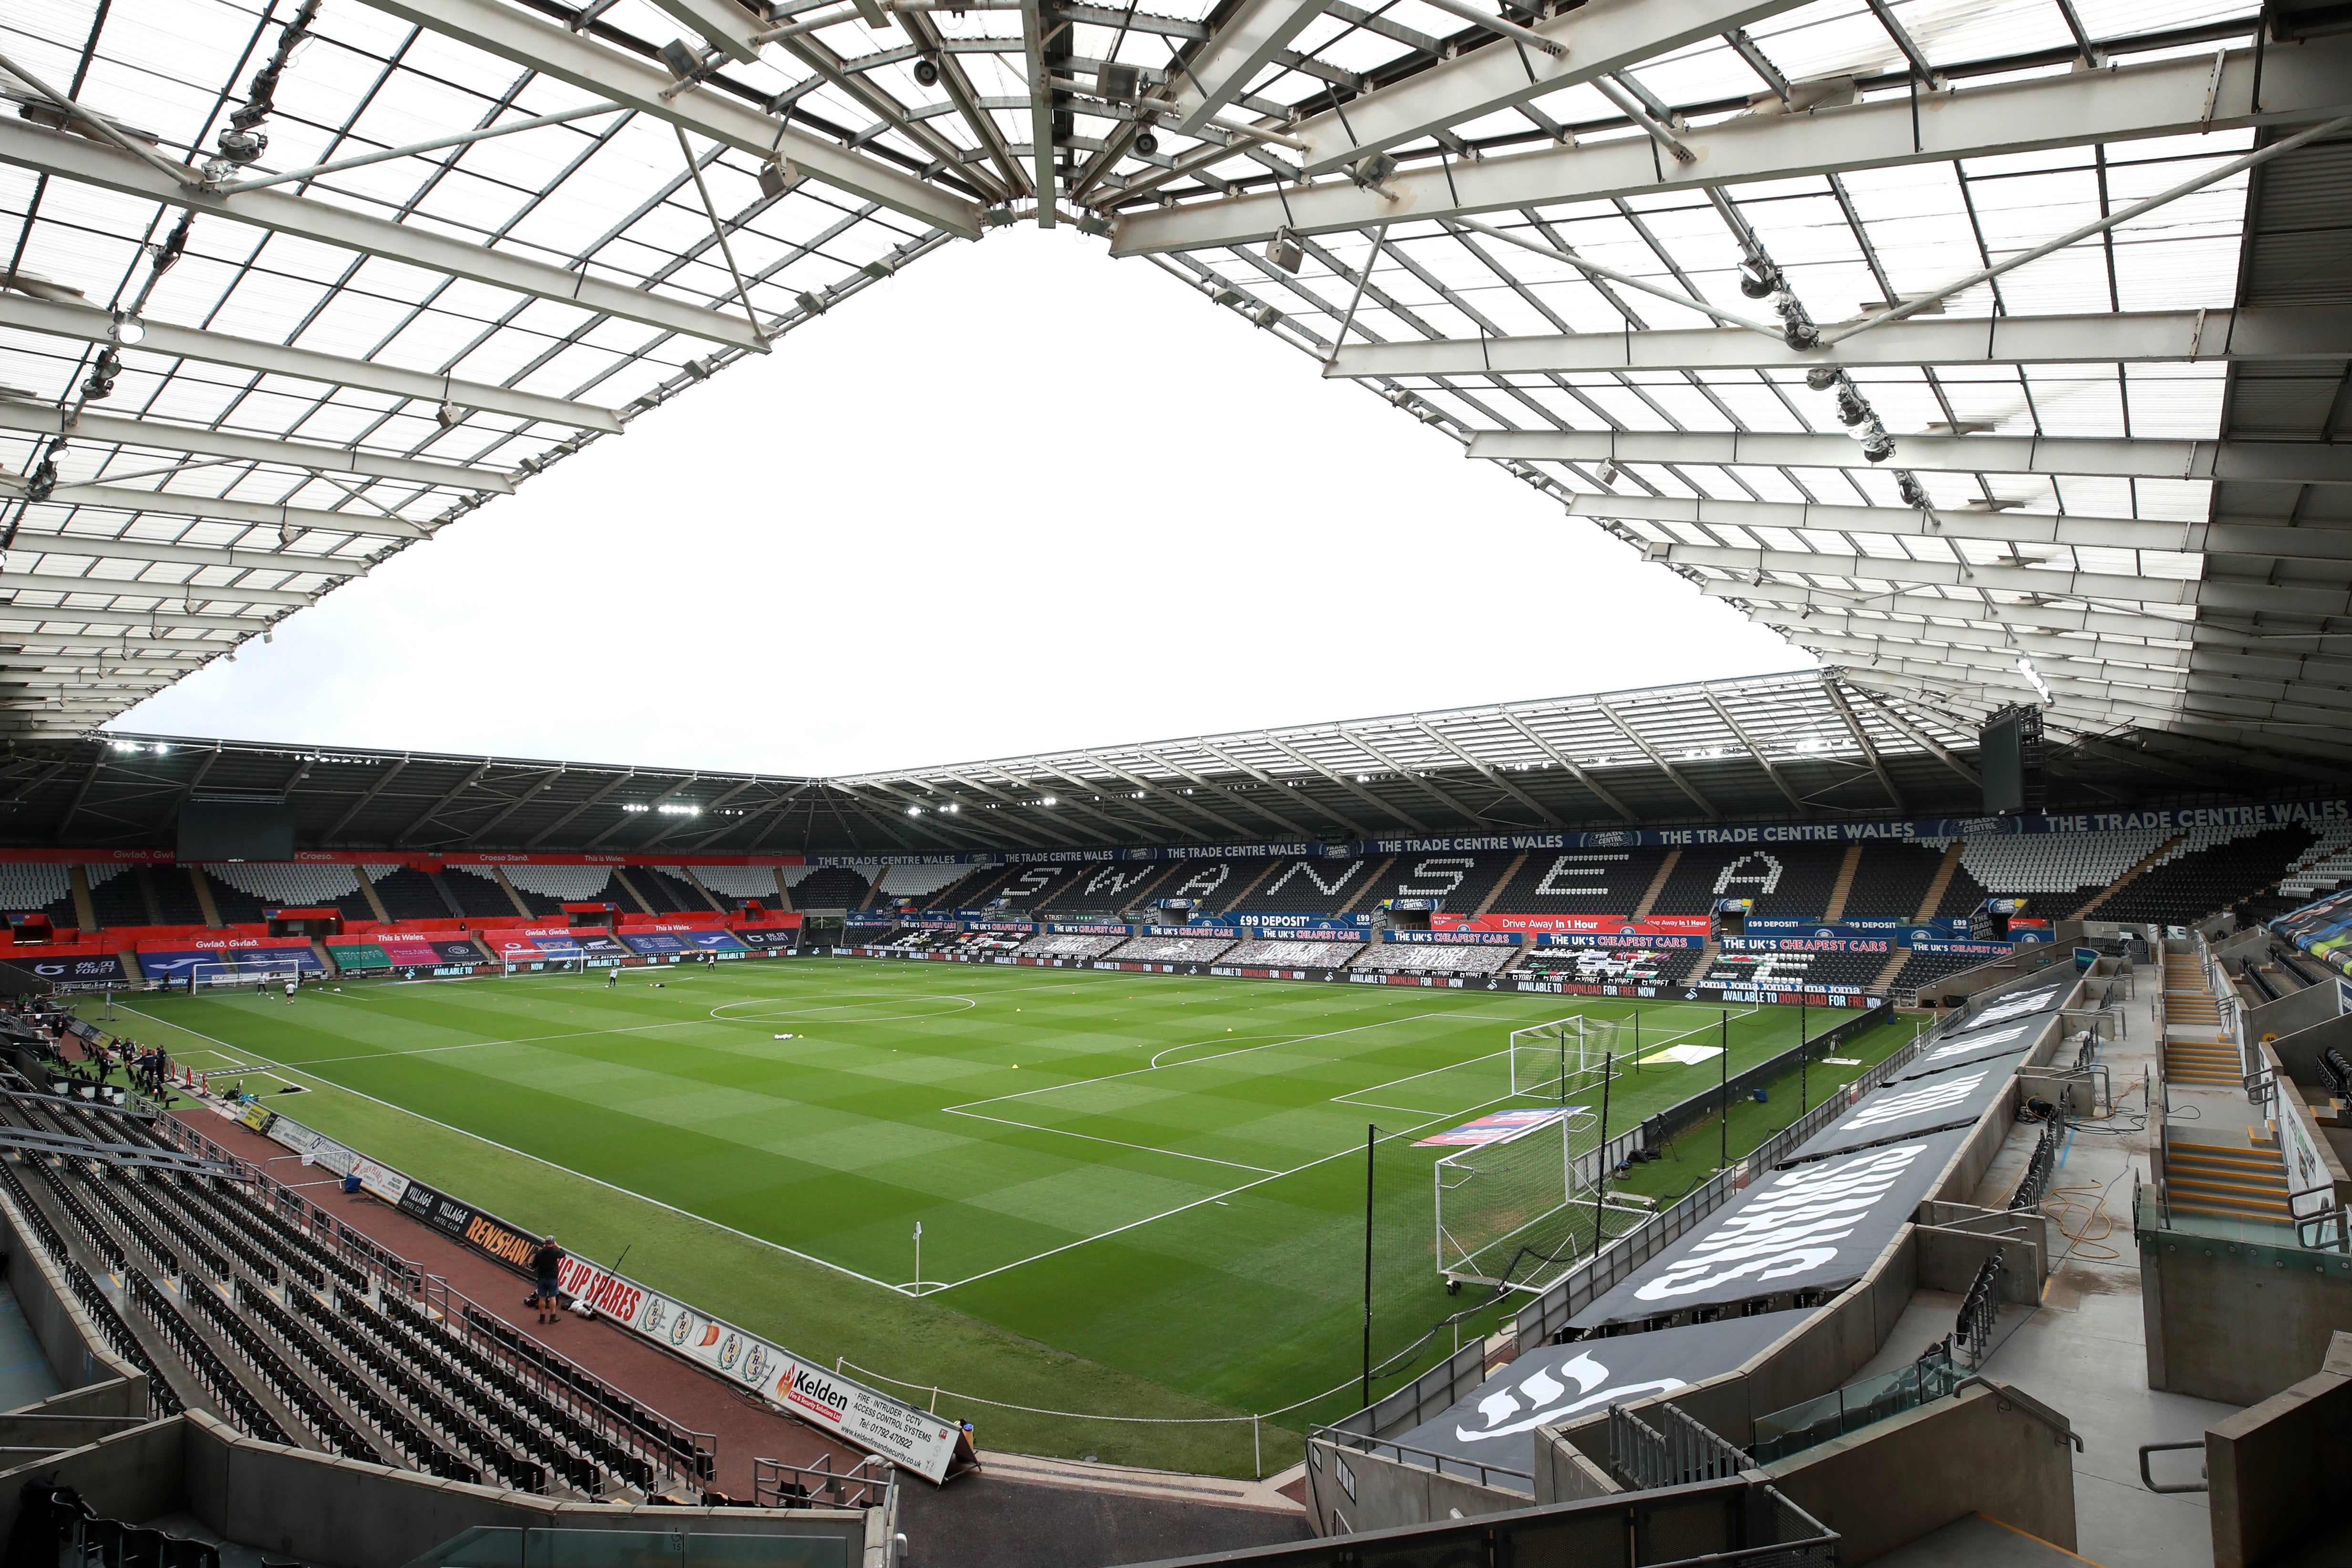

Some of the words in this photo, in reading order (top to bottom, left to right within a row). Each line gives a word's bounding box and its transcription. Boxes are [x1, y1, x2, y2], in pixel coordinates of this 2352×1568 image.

[2046, 816, 2088, 832] THE
[2094, 812, 2171, 830] TRADE
[2178, 806, 2266, 827] CENTRE
[2271, 800, 2348, 821] WALES
[1660, 831, 1693, 845] THE
[1696, 829, 1757, 843] TRADE
[1764, 824, 1838, 841] CENTRE
[1843, 822, 1914, 838] WALES
[1168, 848, 1185, 859] THE
[1188, 847, 1222, 858] TRADE
[1225, 845, 1266, 857] CENTRE
[1268, 844, 1306, 855] WALES
[1378, 840, 1402, 852] THE
[1405, 839, 1449, 851] TRADE
[1454, 837, 1508, 850] CENTRE
[1511, 835, 1562, 848] WALES
[819, 857, 839, 866] THE
[841, 857, 877, 865] TRADE
[881, 856, 921, 865] CENTRE
[922, 855, 955, 864] WALES
[1005, 854, 1019, 862] THE
[1021, 853, 1048, 862] TRADE
[1050, 852, 1081, 861] CENTRE
[1083, 850, 1113, 860] WALES
[1240, 915, 1259, 926] £99
[1502, 919, 1526, 928] Drive
[1529, 920, 1553, 930] Away
[1556, 920, 1565, 928] In
[1567, 920, 1571, 929] 1
[1574, 920, 1598, 929] Hour
[1214, 929, 1234, 937] CARS
[1296, 931, 1336, 939] CHEAPEST
[1337, 931, 1360, 940] CARS
[1394, 933, 1410, 941] THE
[1412, 933, 1432, 942] UK'S
[1434, 933, 1480, 943] CHEAPEST
[1483, 934, 1509, 943] CARS
[1550, 936, 1569, 945] THE
[1571, 936, 1595, 945] UK'S
[1598, 936, 1653, 947] CHEAPEST
[1655, 937, 1687, 947] CARS
[1724, 940, 1746, 949] THE
[1749, 940, 1777, 949] UK'S
[1780, 940, 1846, 951] CHEAPEST
[1849, 940, 1887, 952] CARS
[1950, 944, 1991, 953] CHEAPEST
[587, 959, 613, 967] AVAILABLE
[621, 957, 646, 965] DOWNLOAD
[1350, 974, 1378, 984] AVAILABLE
[1379, 975, 1387, 984] TO
[1387, 975, 1419, 986] DOWNLOAD
[1420, 977, 1432, 986] FOR
[1433, 978, 1448, 987] FREE
[1448, 978, 1464, 988] NOW
[1518, 982, 1552, 993] AVAILABLE
[1553, 983, 1562, 993] TO
[1563, 984, 1602, 995] DOWNLOAD
[1603, 985, 1617, 995] FOR
[1619, 986, 1636, 996] FREE
[1638, 987, 1656, 997] NOW
[1723, 990, 1765, 1002] AVAILABLE
[1766, 992, 1777, 1003] TO
[1779, 993, 1827, 1005] DOWNLOAD
[1828, 995, 1846, 1006] FOR
[1848, 996, 1866, 1008] FREE
[1867, 997, 1881, 1008] NOW
[407, 1186, 434, 1208] VILLAGE
[403, 1199, 415, 1210] HOTEL
[415, 1205, 426, 1215] CLUB
[439, 1200, 468, 1224] VILLAGE
[433, 1216, 447, 1226] HOTEL
[448, 1221, 460, 1232] CLUB
[465, 1216, 535, 1267] RENISHAW
[567, 1263, 592, 1295] UP
[585, 1271, 641, 1322] SPARES
[793, 1370, 848, 1411] Kelden
[801, 1396, 816, 1409] Security
[815, 1404, 833, 1417] Solutions
[833, 1412, 841, 1421] Ltd
[857, 1393, 871, 1404] FIRE
[873, 1400, 902, 1418] INTRUDER
[906, 1414, 923, 1426] CCTV
[853, 1402, 876, 1418] ACCESS
[876, 1413, 903, 1431] CONTROL
[904, 1425, 932, 1443] SYSTEMS
[859, 1418, 870, 1430] Tel:
[870, 1424, 887, 1439] 01792
[889, 1435, 913, 1449] 470922
[841, 1425, 922, 1468] www.keldenfireandsecurity.co.uk
